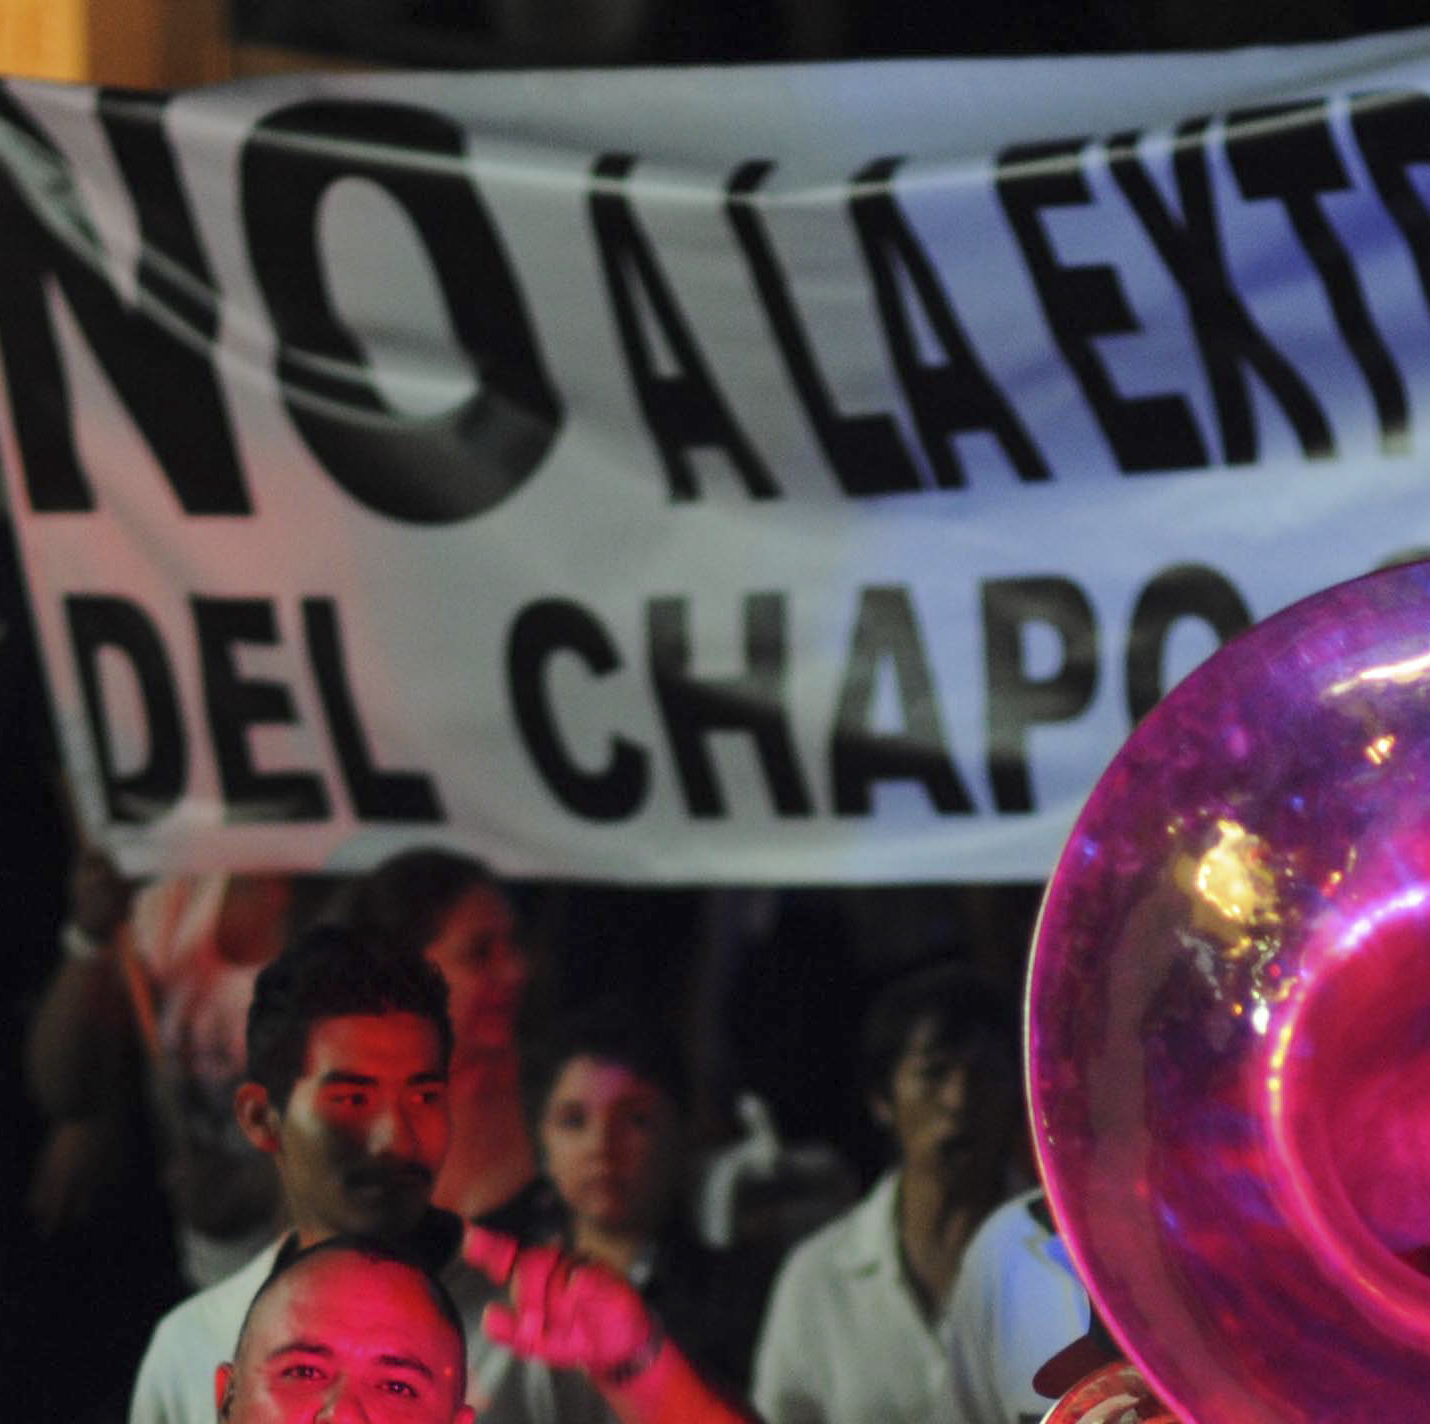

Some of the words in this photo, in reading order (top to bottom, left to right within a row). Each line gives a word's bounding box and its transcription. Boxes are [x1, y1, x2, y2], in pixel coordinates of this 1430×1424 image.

[587, 156, 783, 503] A
[724, 156, 1055, 496] LA
[62, 593, 449, 826] DEL
